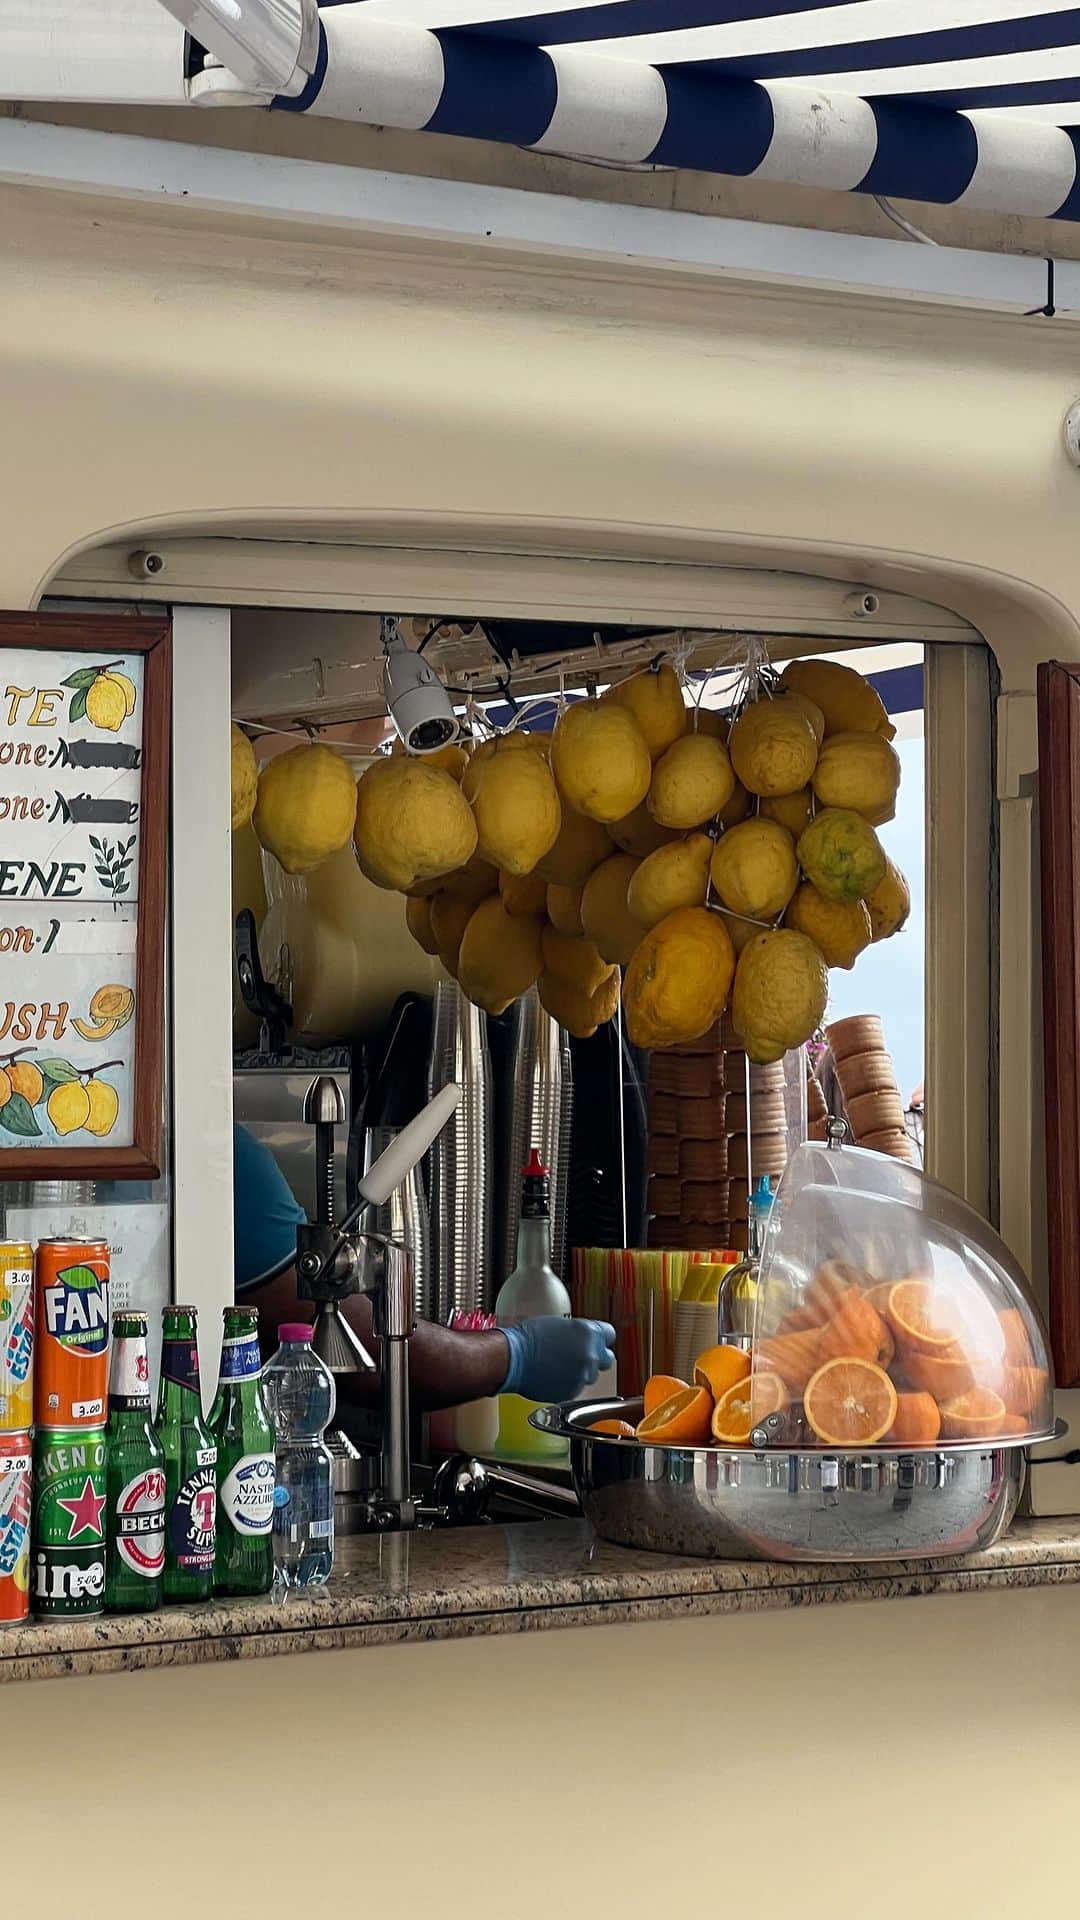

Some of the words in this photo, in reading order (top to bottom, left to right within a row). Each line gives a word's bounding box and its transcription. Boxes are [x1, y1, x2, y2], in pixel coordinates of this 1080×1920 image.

[5, 686, 64, 726] TE
[79, 1404, 100, 1417] 3.00
[4, 1459, 26, 1472] 3.00
